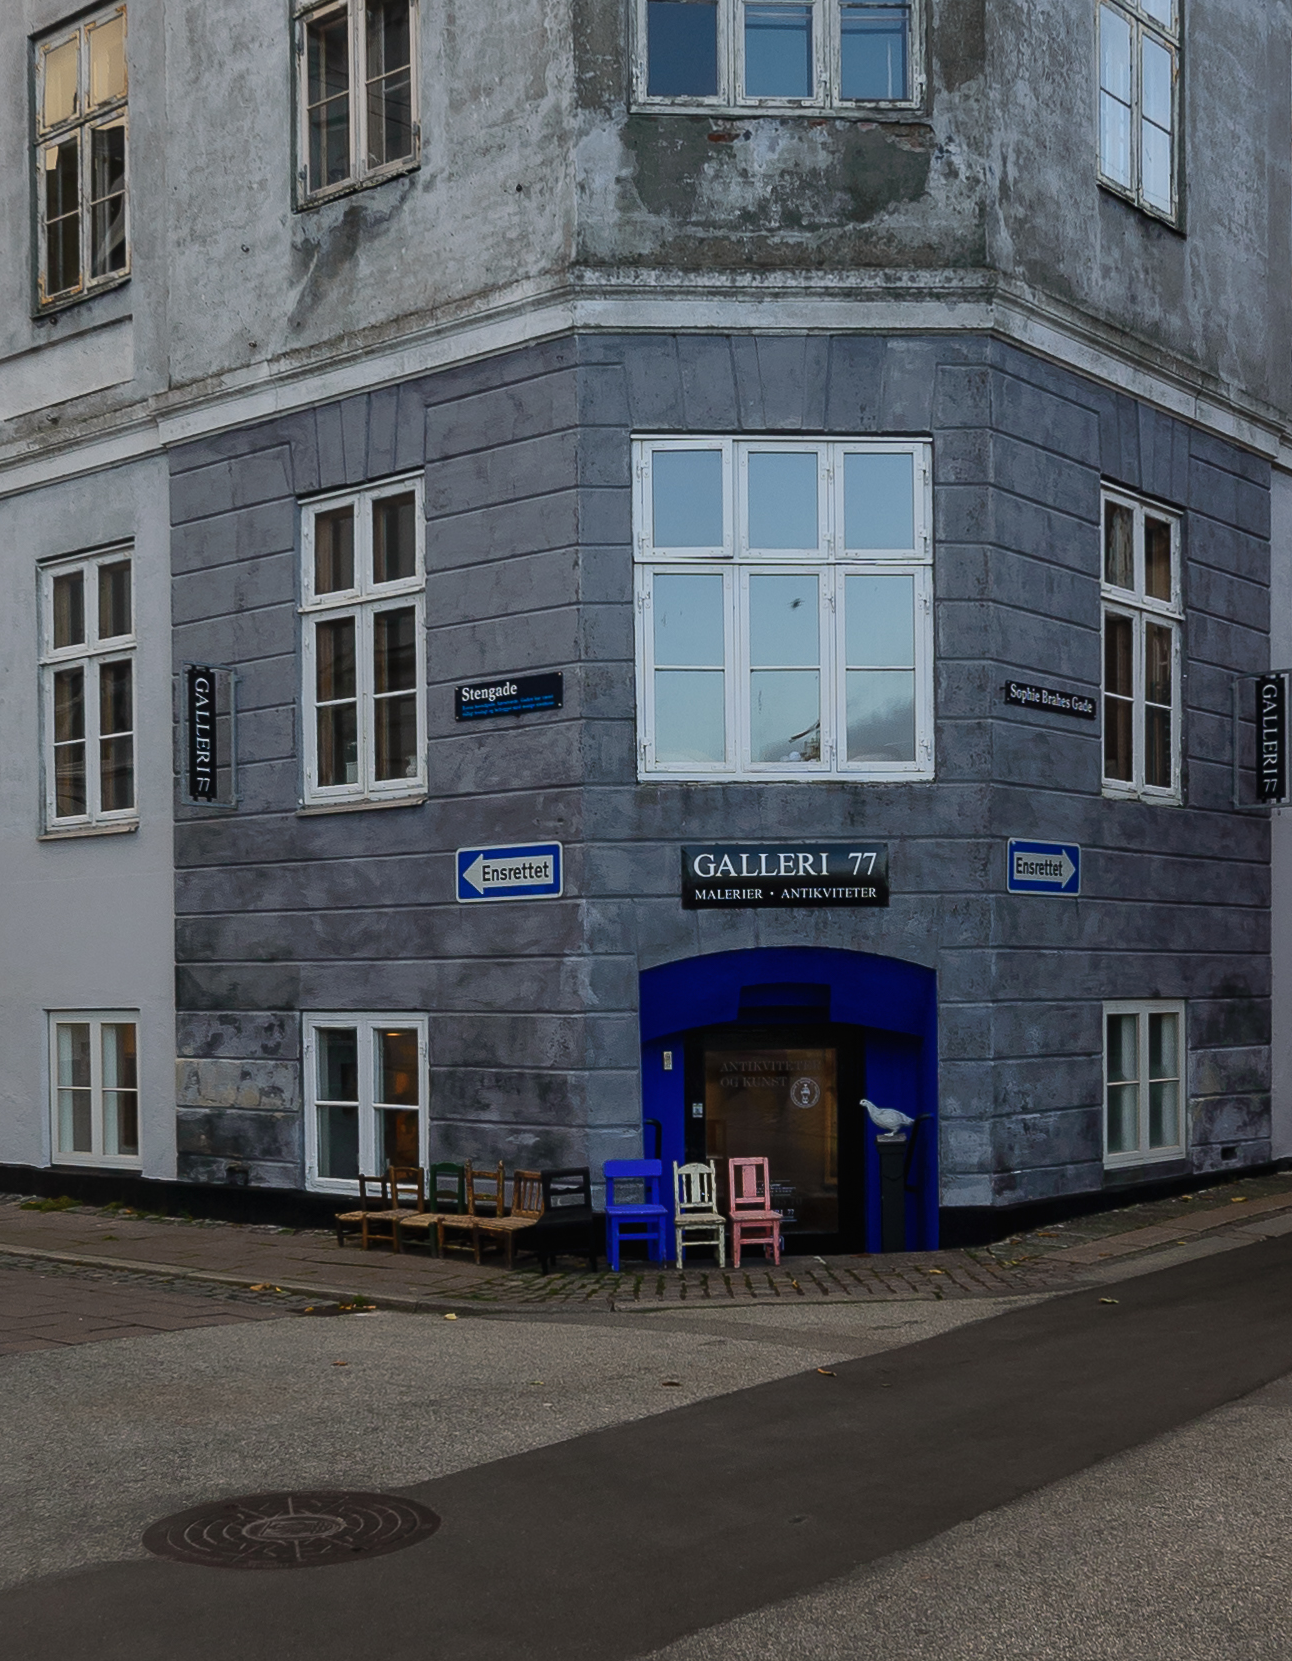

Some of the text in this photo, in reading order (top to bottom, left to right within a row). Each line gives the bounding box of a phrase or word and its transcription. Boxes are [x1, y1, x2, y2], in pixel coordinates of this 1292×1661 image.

[461, 681, 518, 702] Stengade
[1010, 683, 1093, 713] Sophie Brahes Gade
[194, 677, 211, 792] GALLERI 77
[1262, 684, 1278, 793] GALLERI 77
[482, 861, 549, 882] Ensrettet
[693, 852, 877, 878] GALLERI 77
[1016, 857, 1063, 877] Ensrettet
[695, 887, 877, 900] MALERIER ANTIKVITETER
[720, 1059, 821, 1073] ANTIKVITETER
[720, 1076, 788, 1089] OG KUNST
